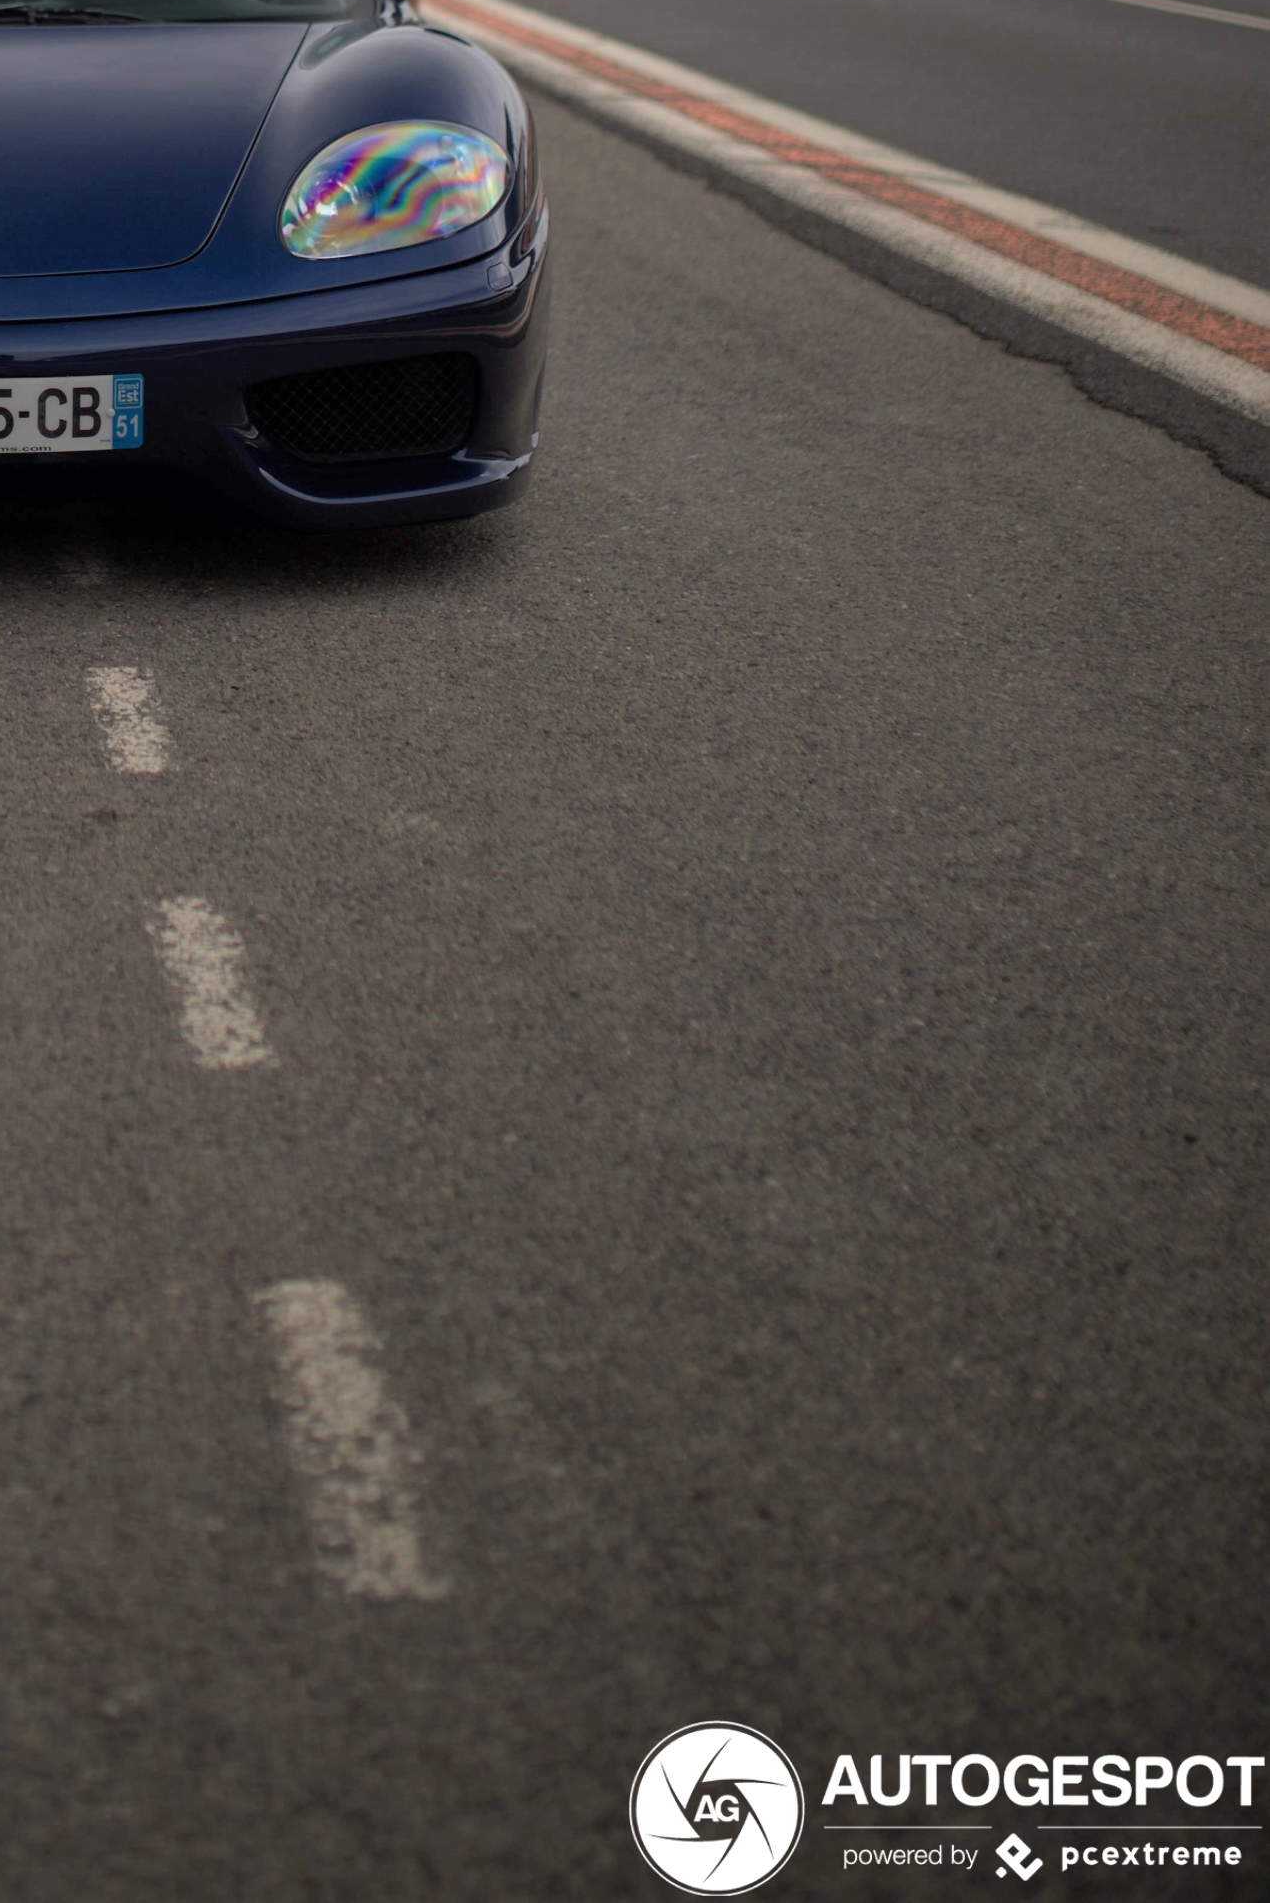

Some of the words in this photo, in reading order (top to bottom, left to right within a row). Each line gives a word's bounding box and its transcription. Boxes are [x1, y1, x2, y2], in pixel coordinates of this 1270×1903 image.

[118, 382, 140, 390] Grand
[117, 389, 139, 403] Est
[116, 414, 140, 439] 51
